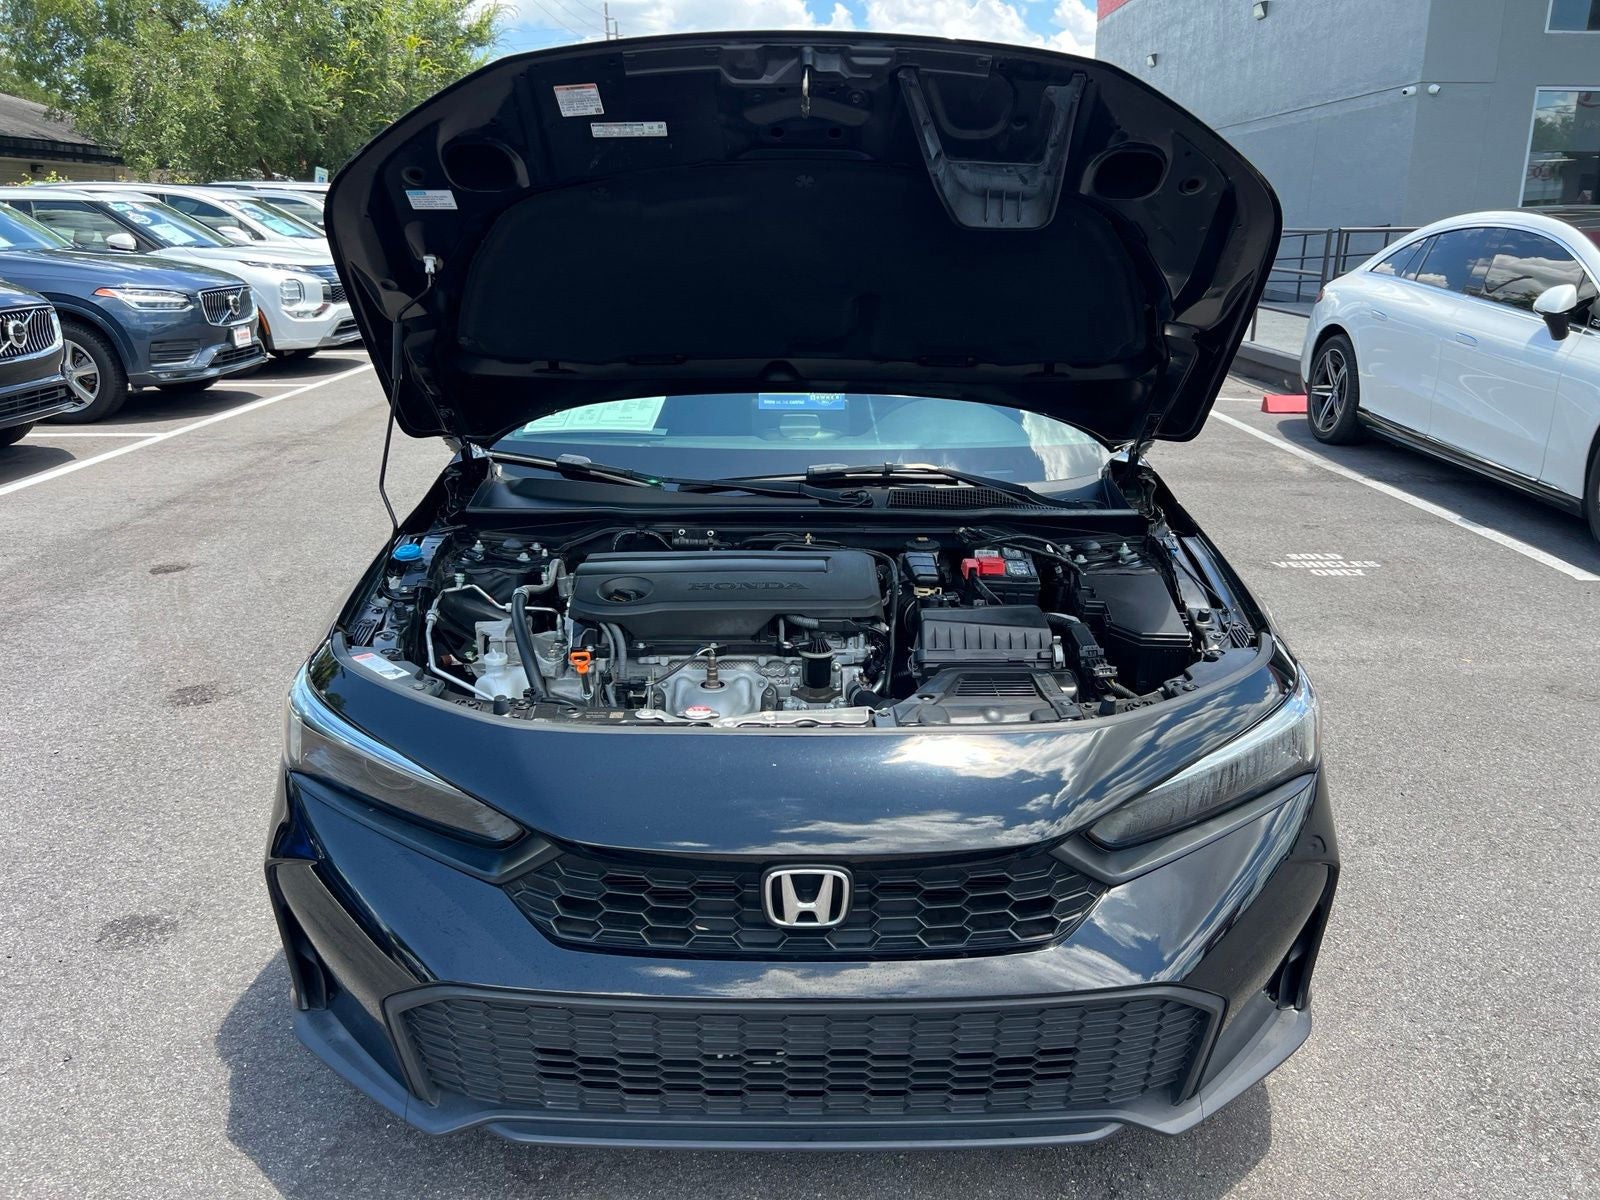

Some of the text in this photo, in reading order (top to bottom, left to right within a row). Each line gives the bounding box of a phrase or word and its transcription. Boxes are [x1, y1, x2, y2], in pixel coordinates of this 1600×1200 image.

[1270, 560, 1382, 568] VEHICLES
[1309, 568, 1366, 576] ONLY
[687, 582, 810, 591] HONDA
